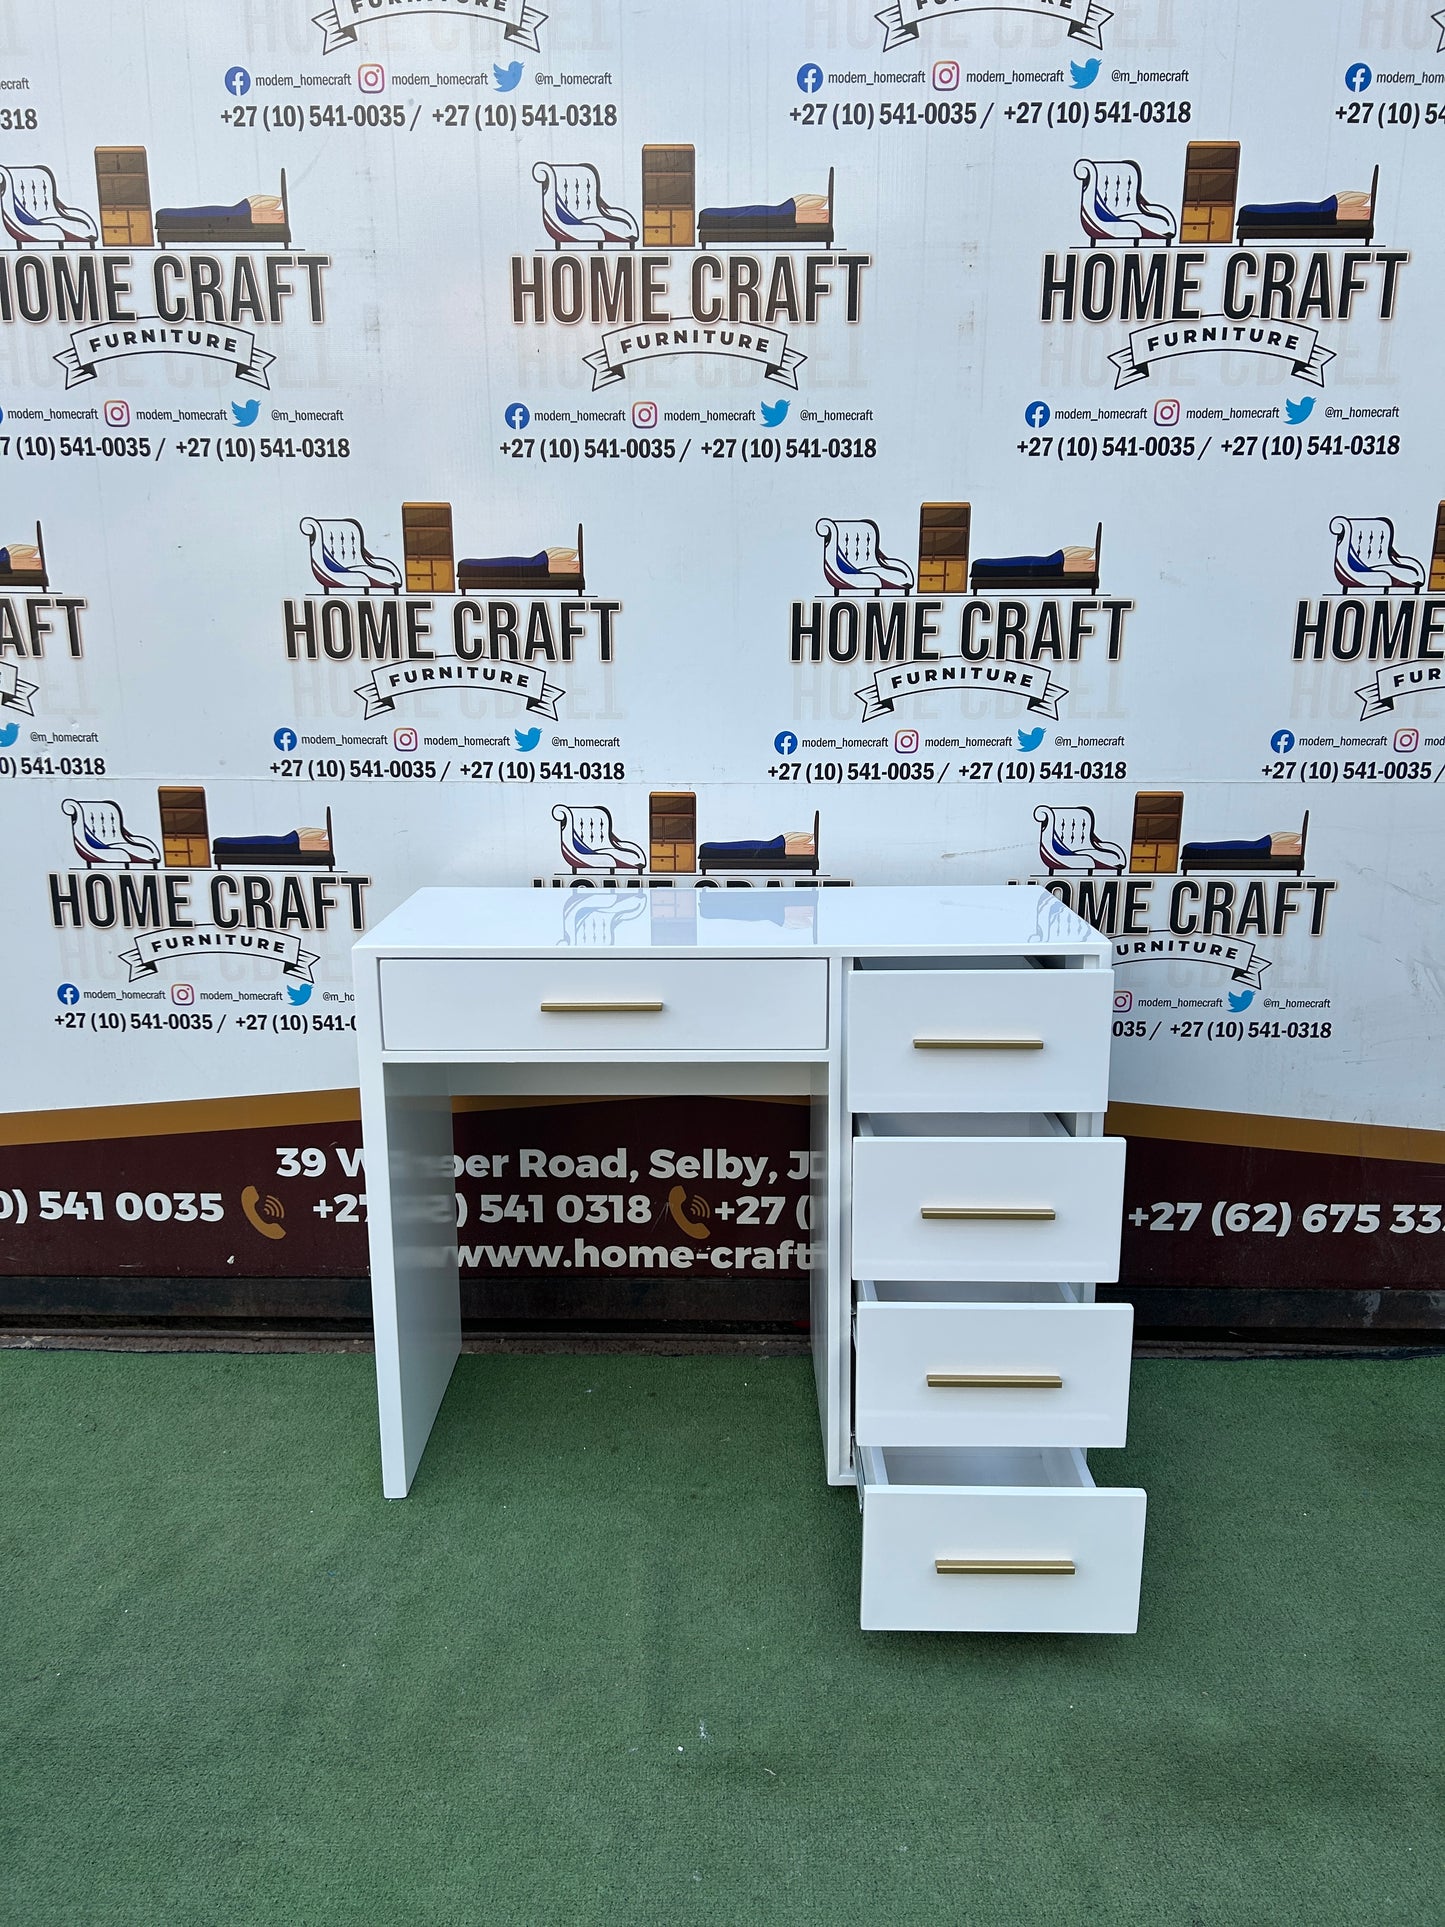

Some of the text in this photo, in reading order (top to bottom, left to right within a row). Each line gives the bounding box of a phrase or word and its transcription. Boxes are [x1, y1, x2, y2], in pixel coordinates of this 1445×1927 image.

[0, 77, 31, 91] ecraft
[534, 71, 613, 88] @m_homecraft
[1111, 69, 1190, 85] @m_homecraft
[1376, 71, 1445, 86] modern_hom
[153, 256, 329, 322] CRAFT
[511, 256, 870, 323] HOME CRAFT
[1041, 252, 1408, 320] HOME CRAFT
[89, 329, 238, 353] FURNITURE
[620, 329, 769, 354] FURNITURE
[1147, 326, 1299, 352] FURNITURE
[270, 409, 345, 423] @m_homecraft
[799, 409, 874, 424] @m_homecraft
[1324, 405, 1400, 421] @m_homecraft
[0, 598, 86, 657] AFT
[283, 599, 620, 661] HOME CRAFT
[790, 600, 1132, 661] HOME CRAFT
[1293, 599, 1445, 660] HOME
[389, 665, 530, 688] FURNITURE
[890, 666, 1034, 689] FURNITURE
[1393, 667, 1442, 687] FUR
[29, 731, 100, 745] @m_homecraft
[551, 736, 621, 749] @m_homecraft
[1054, 735, 1126, 749] @m_homecraft
[48, 873, 370, 930] HOME CRAFT
[1169, 880, 1336, 935] CRAFT
[151, 934, 285, 953] FURNITURE
[1116, 940, 1239, 960] URNITURE
[322, 991, 355, 1004] @m_ho
[1263, 997, 1331, 1010] @m_homecraft
[276, 1148, 327, 1177] 39
[520, 1147, 639, 1183] Road,
[649, 1149, 778, 1187] Selby,
[786, 1151, 810, 1180] J
[39, 1191, 104, 1221] 541
[115, 1192, 224, 1222] 0035
[479, 1194, 544, 1223] 541
[556, 1194, 652, 1224] 0318
[714, 1196, 786, 1225] +27
[1128, 1201, 1445, 1237] +27 (62) 675 33
[457, 1238, 813, 1270] www.home-craft
